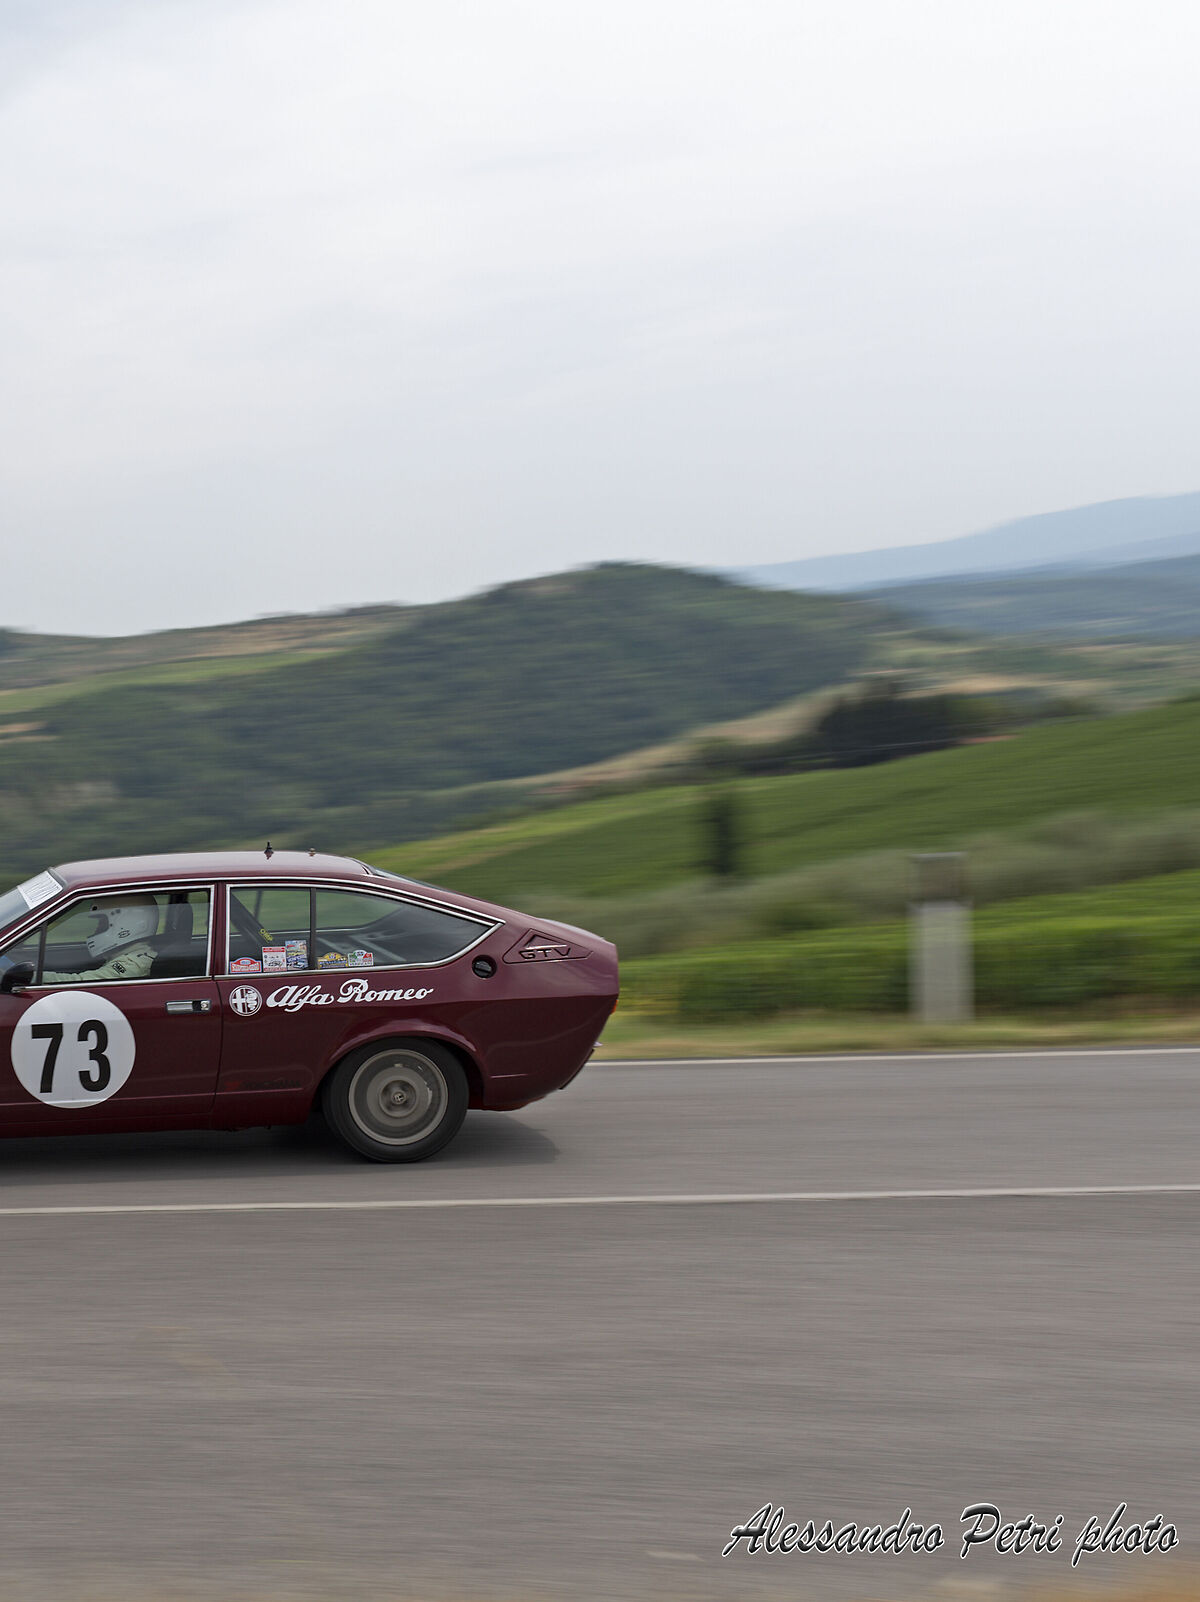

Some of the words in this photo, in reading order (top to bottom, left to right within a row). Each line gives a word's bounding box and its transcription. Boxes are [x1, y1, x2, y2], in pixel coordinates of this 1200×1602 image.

[519, 947, 571, 960] GTV
[266, 985, 334, 1012] Alfa
[337, 979, 433, 1003] Romeo
[31, 1020, 111, 1093] 73
